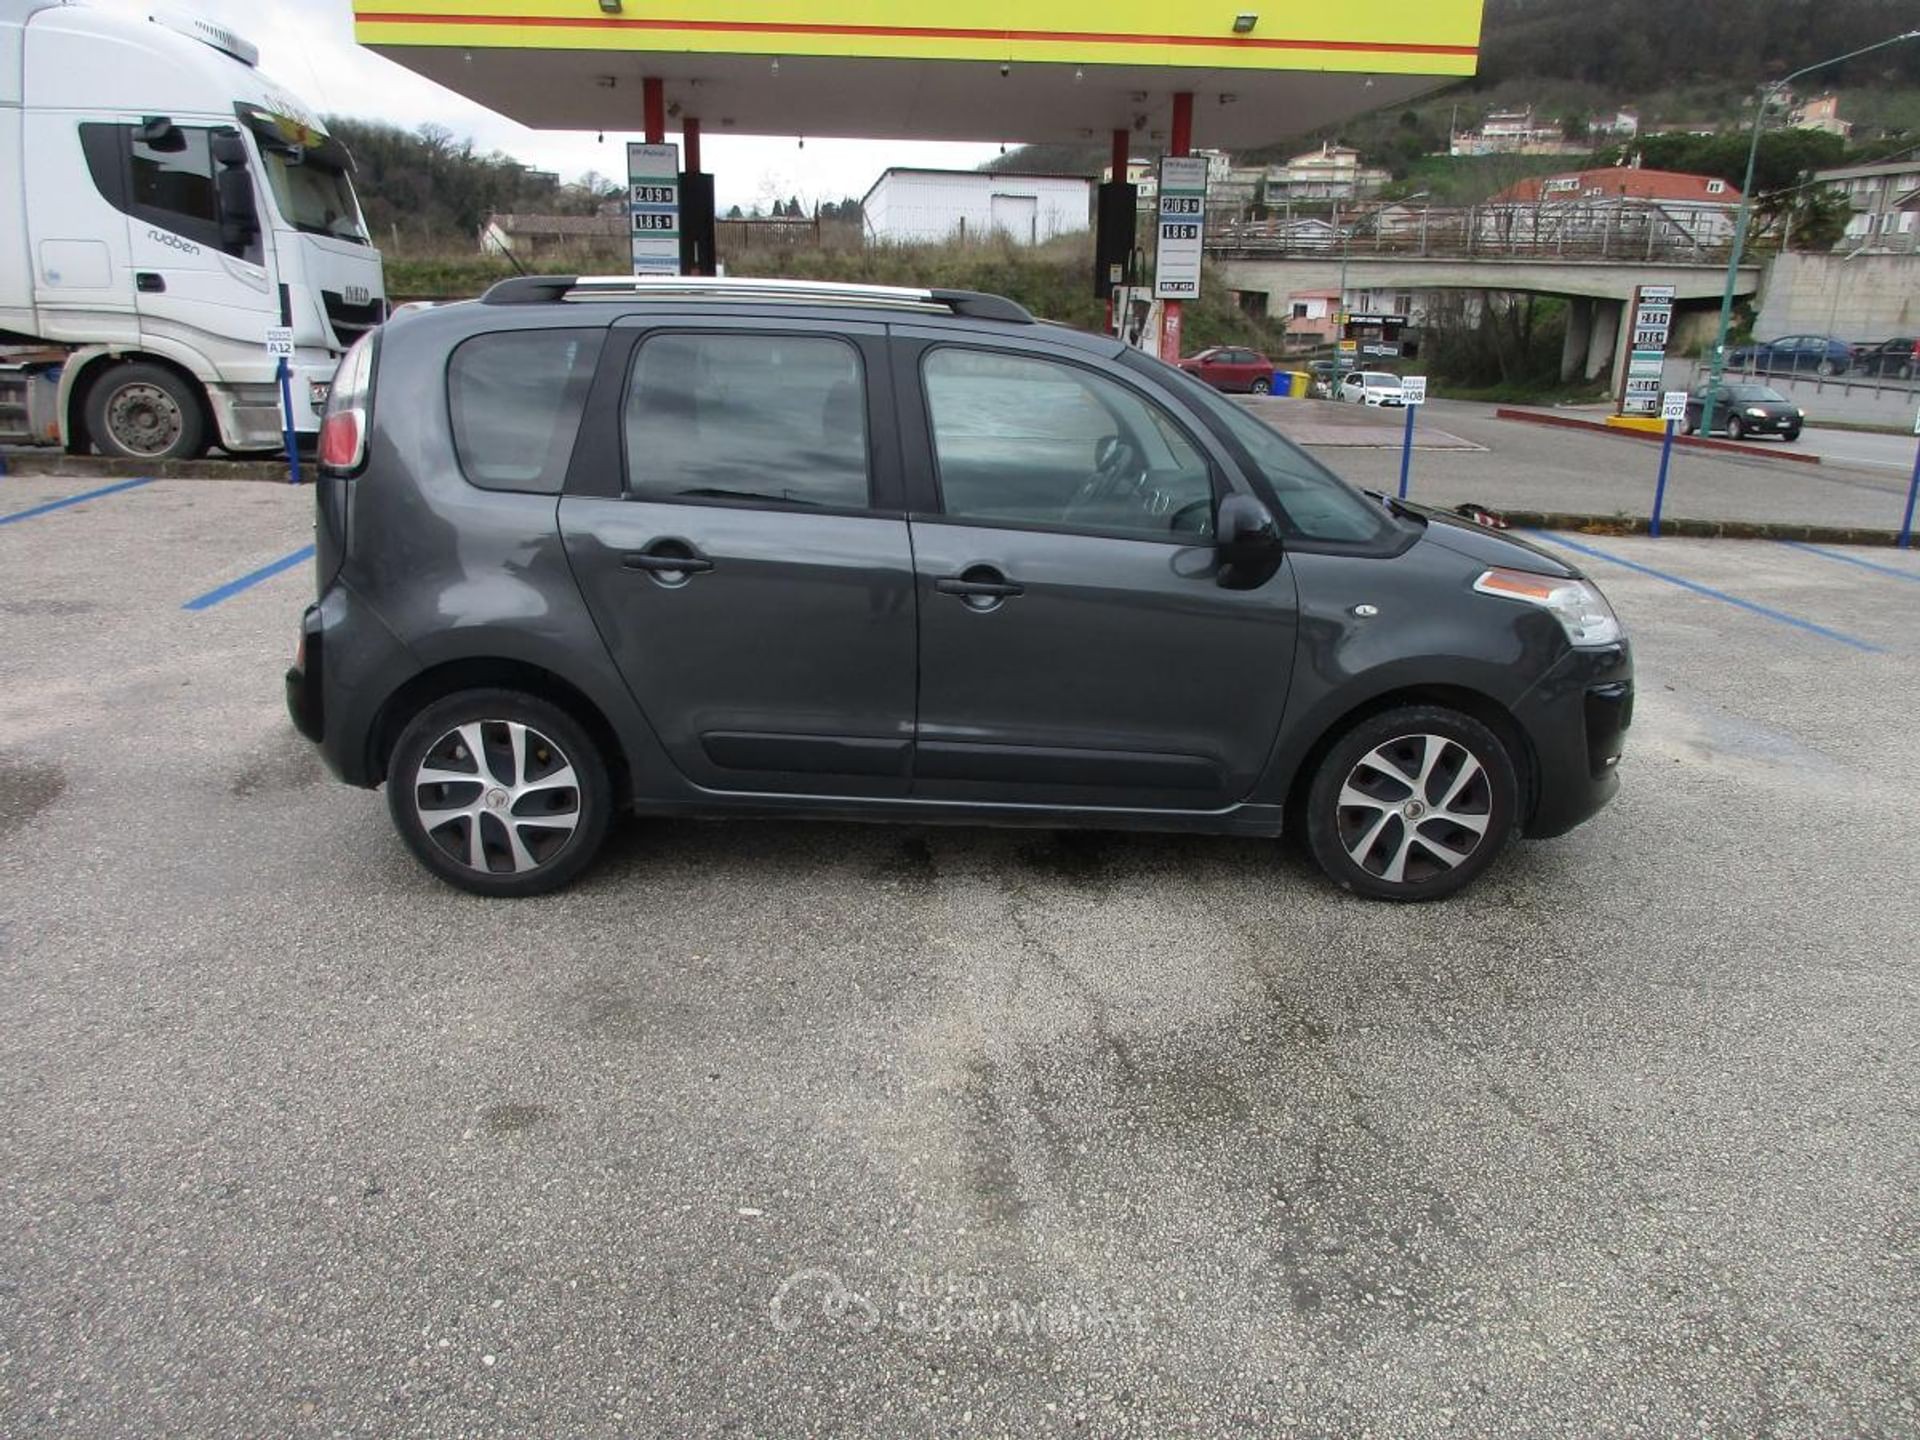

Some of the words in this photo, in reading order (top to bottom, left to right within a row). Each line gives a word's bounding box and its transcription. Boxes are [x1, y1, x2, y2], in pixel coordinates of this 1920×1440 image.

[270, 342, 291, 353] A12
[1402, 391, 1424, 401] A08
[1664, 406, 1684, 416] A07
